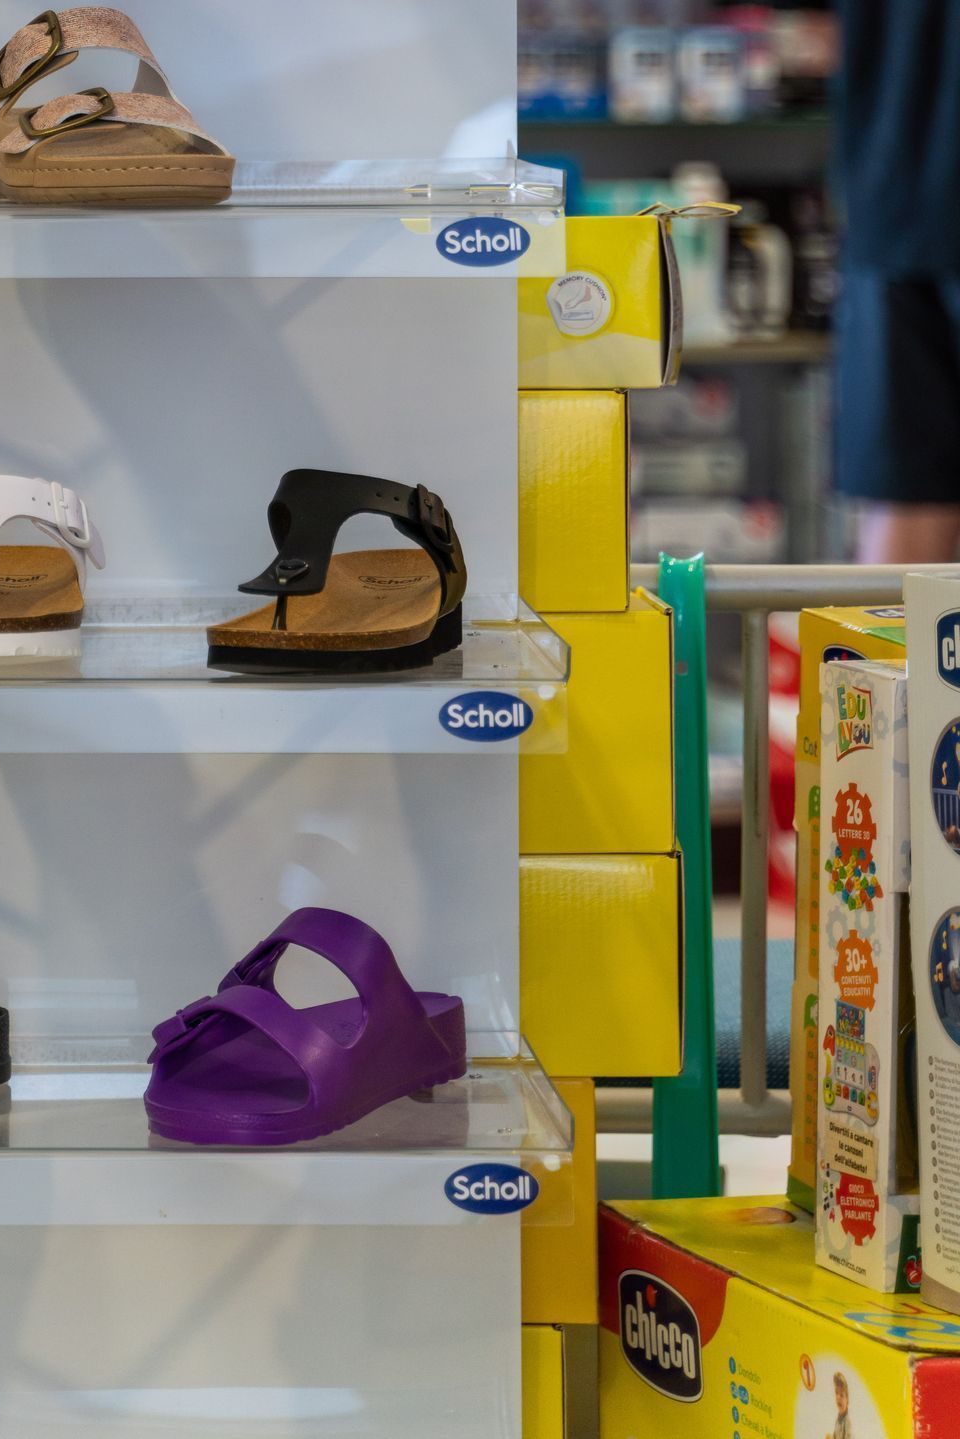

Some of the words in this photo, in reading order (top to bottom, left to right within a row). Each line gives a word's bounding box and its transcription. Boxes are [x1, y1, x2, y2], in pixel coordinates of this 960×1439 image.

[444, 227, 522, 255] Scholl
[557, 275, 584, 287] MEMORY
[836, 686, 867, 721] EDU
[447, 703, 525, 729] Scholl
[846, 798, 863, 825] 26
[838, 828, 863, 840] LETTERE
[845, 947, 868, 973] 30+
[841, 975, 872, 985] CONTENUTI
[843, 987, 871, 997] EDUCATIVI
[854, 1134, 874, 1148] cantare
[453, 1175, 531, 1201] Scholl
[848, 1183, 865, 1194] GIOCO
[841, 1195, 876, 1209] ELETTRONICO
[844, 1209, 872, 1221] PARLANTE
[828, 1253, 867, 1276] www.chicco.com
[625, 1288, 696, 1380] chicco
